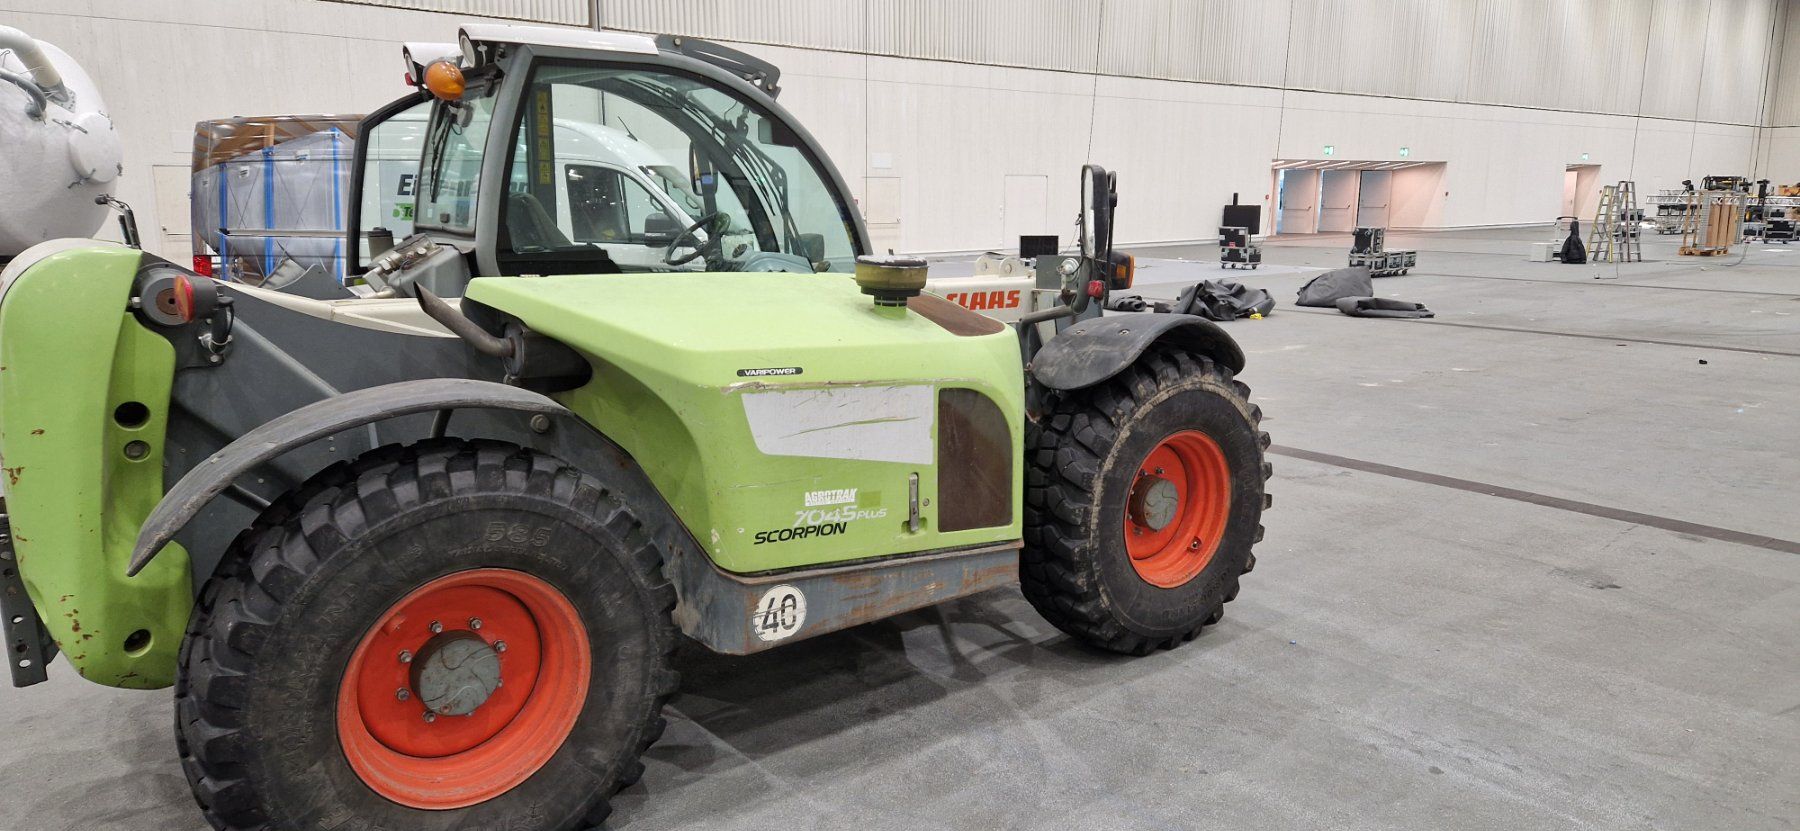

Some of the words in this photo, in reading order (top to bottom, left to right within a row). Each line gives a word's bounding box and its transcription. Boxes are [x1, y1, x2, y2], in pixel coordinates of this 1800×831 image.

[744, 368, 796, 376] VARIPOWER
[804, 488, 857, 506] AGROTRAK
[793, 505, 857, 527] 7045
[857, 508, 888, 520] PLUS
[754, 523, 847, 545] SCORPION
[762, 593, 797, 633] 40
